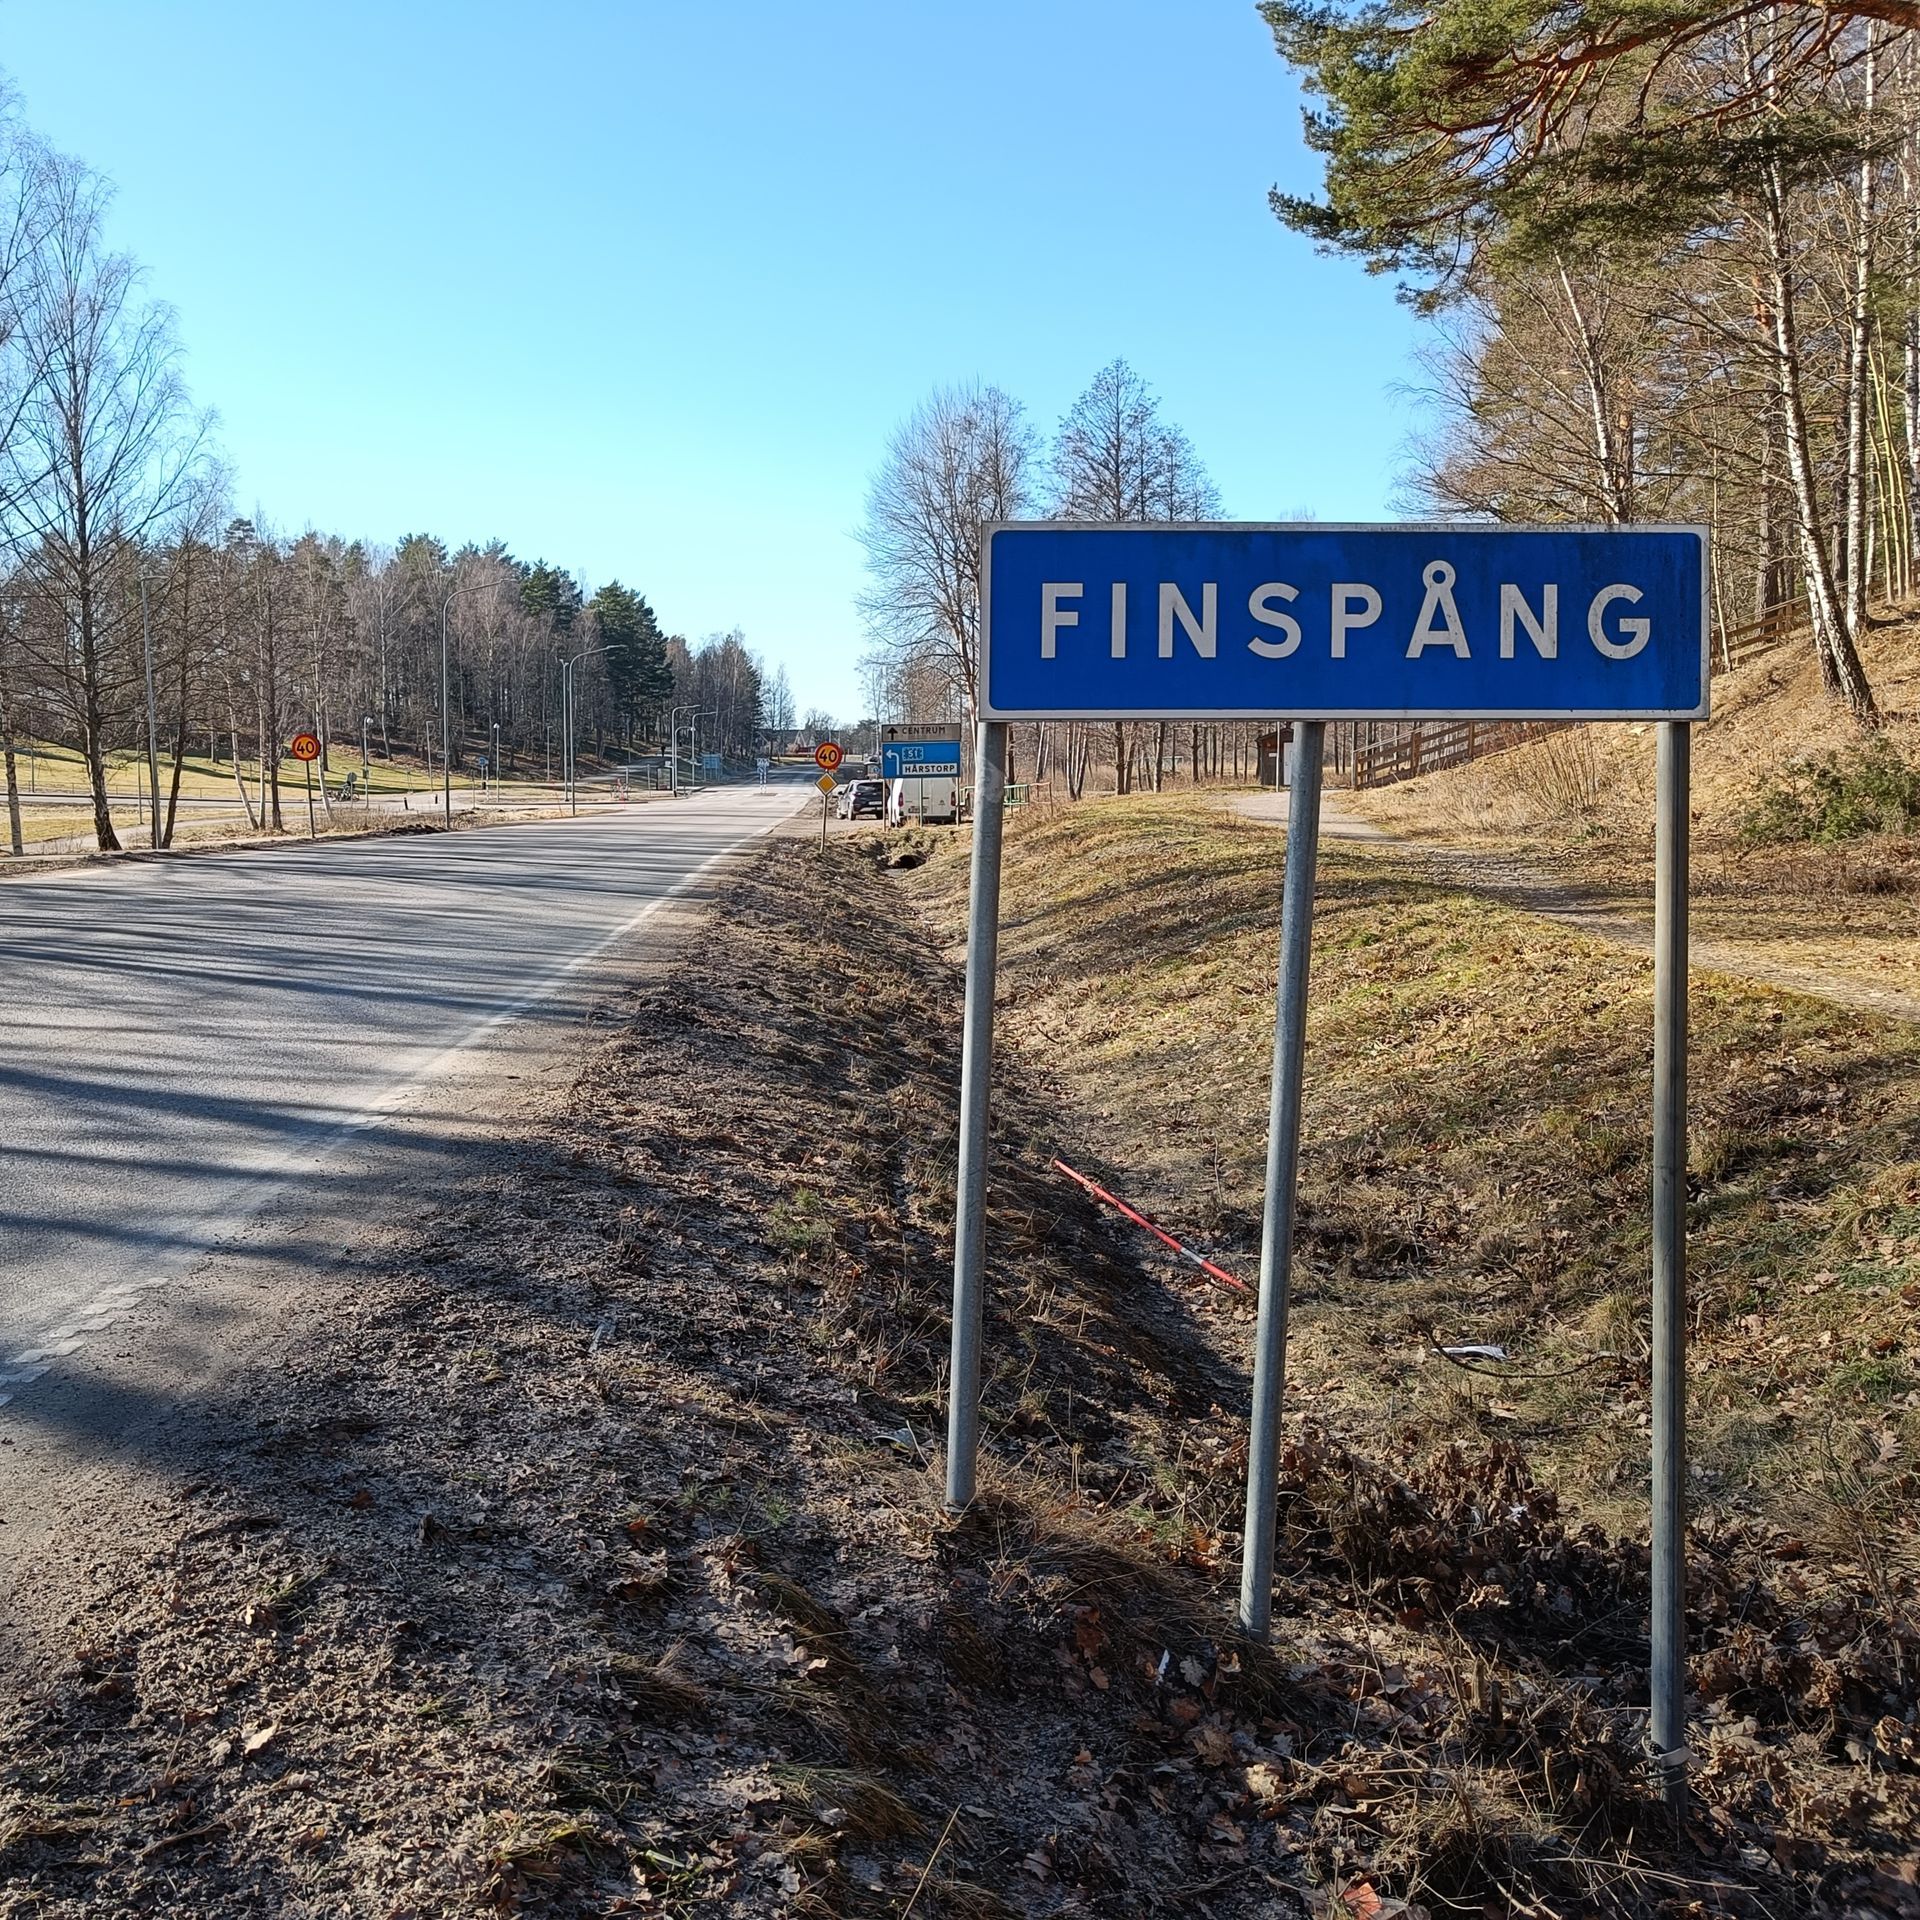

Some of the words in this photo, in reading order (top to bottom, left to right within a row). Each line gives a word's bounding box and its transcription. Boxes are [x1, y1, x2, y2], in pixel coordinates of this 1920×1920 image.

[1040, 559, 1651, 660] FINSPÅNG
[901, 726, 946, 735] CENTRUM
[296, 741, 315, 754] 40
[818, 749, 838, 762] 40
[904, 764, 955, 773] HÅRSTORP
